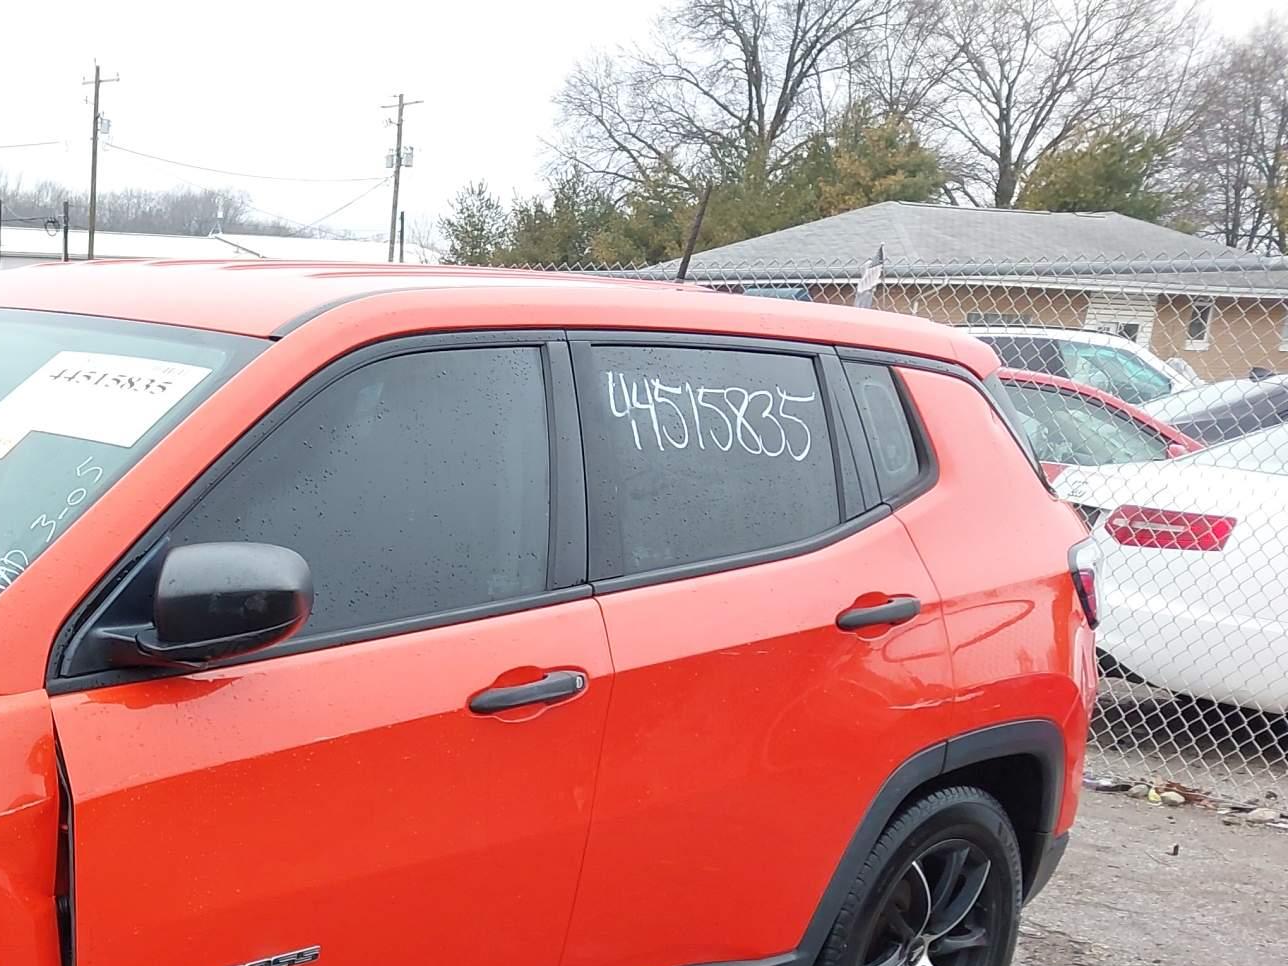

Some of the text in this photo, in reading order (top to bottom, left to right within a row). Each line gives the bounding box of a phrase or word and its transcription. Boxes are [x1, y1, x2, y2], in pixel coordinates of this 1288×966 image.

[49, 368, 173, 395] 44515835
[607, 371, 815, 461] 44515835
[30, 456, 104, 543] 3-05
